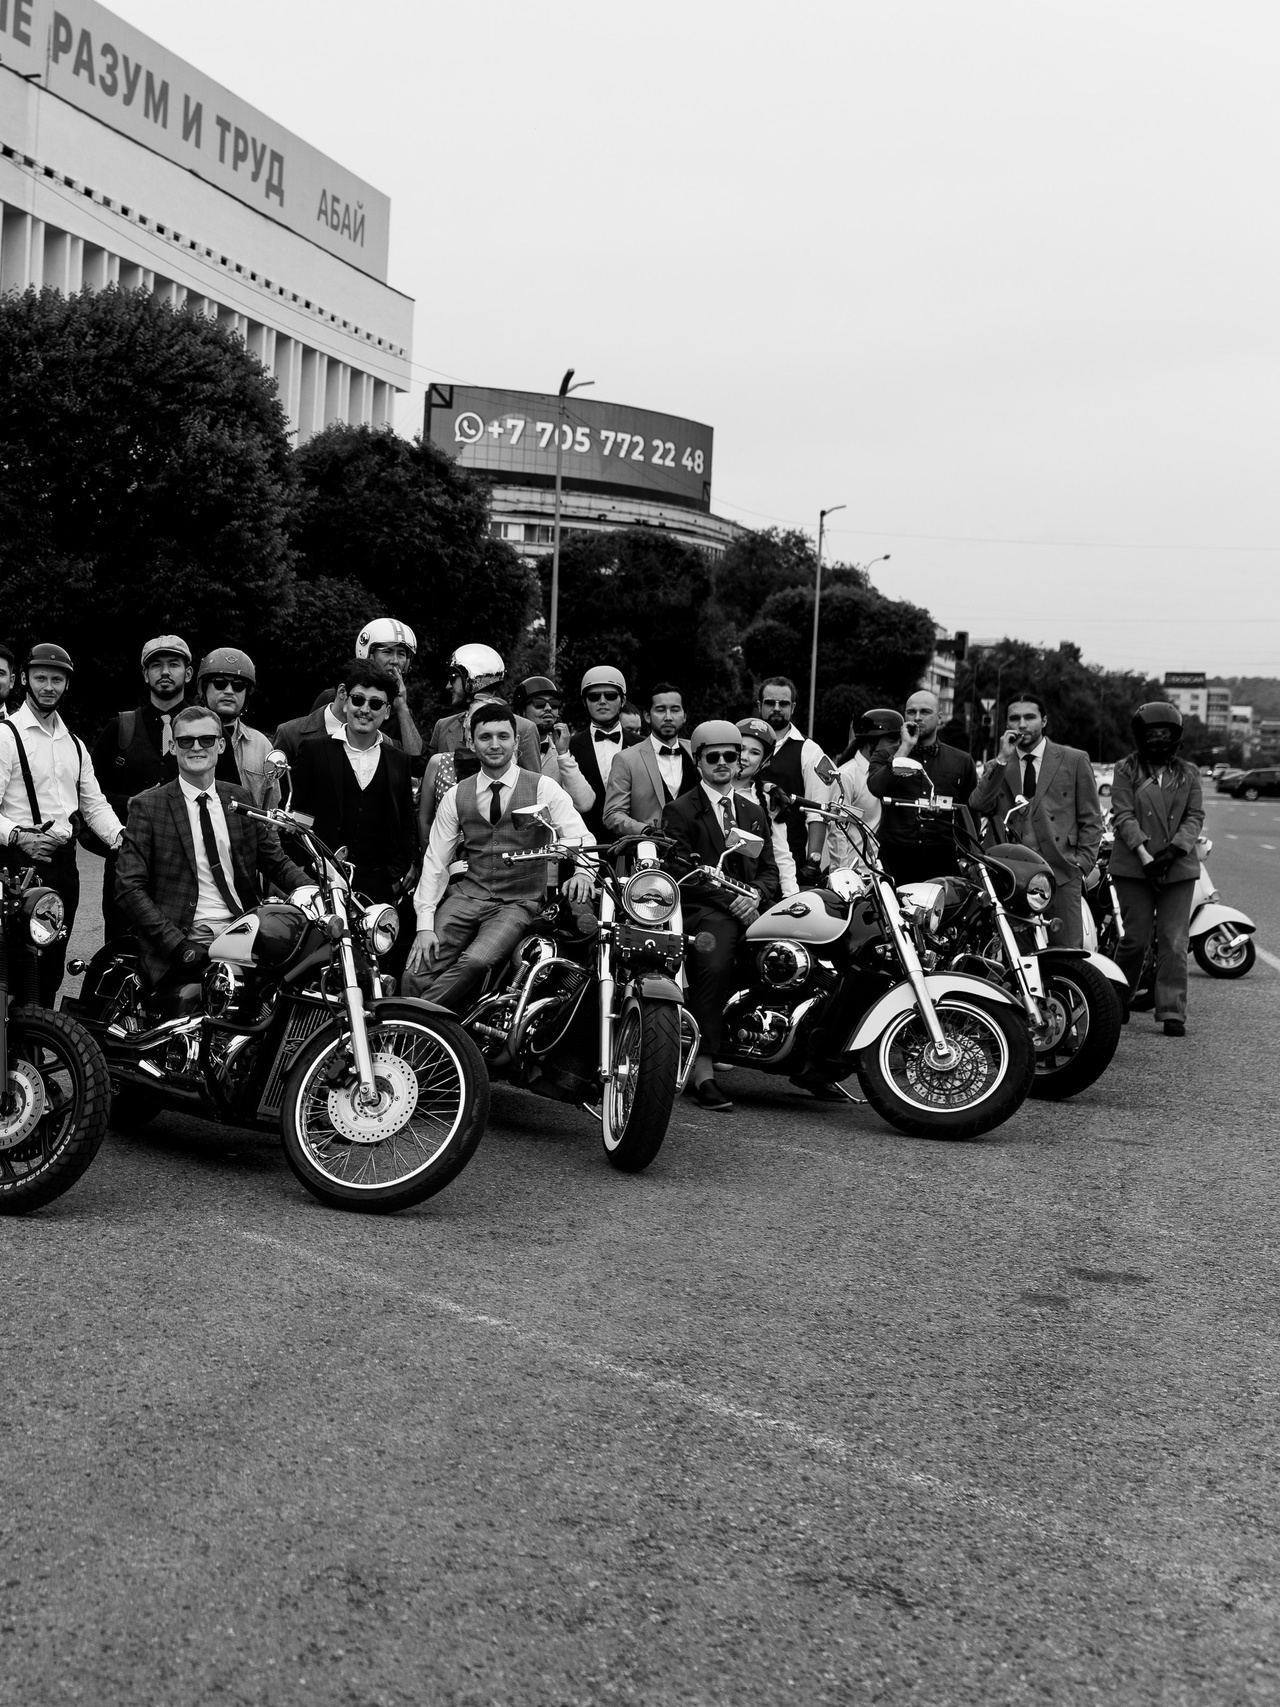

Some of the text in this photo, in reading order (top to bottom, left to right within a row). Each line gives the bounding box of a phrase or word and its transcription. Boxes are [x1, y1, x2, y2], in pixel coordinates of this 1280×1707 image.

[52, 10, 170, 131] РАЗУМ
[182, 93, 203, 149] И
[215, 114, 285, 207] ТРУД
[317, 187, 366, 248] АБАЙ
[487, 418, 705, 475] +7 705 772 22 48
